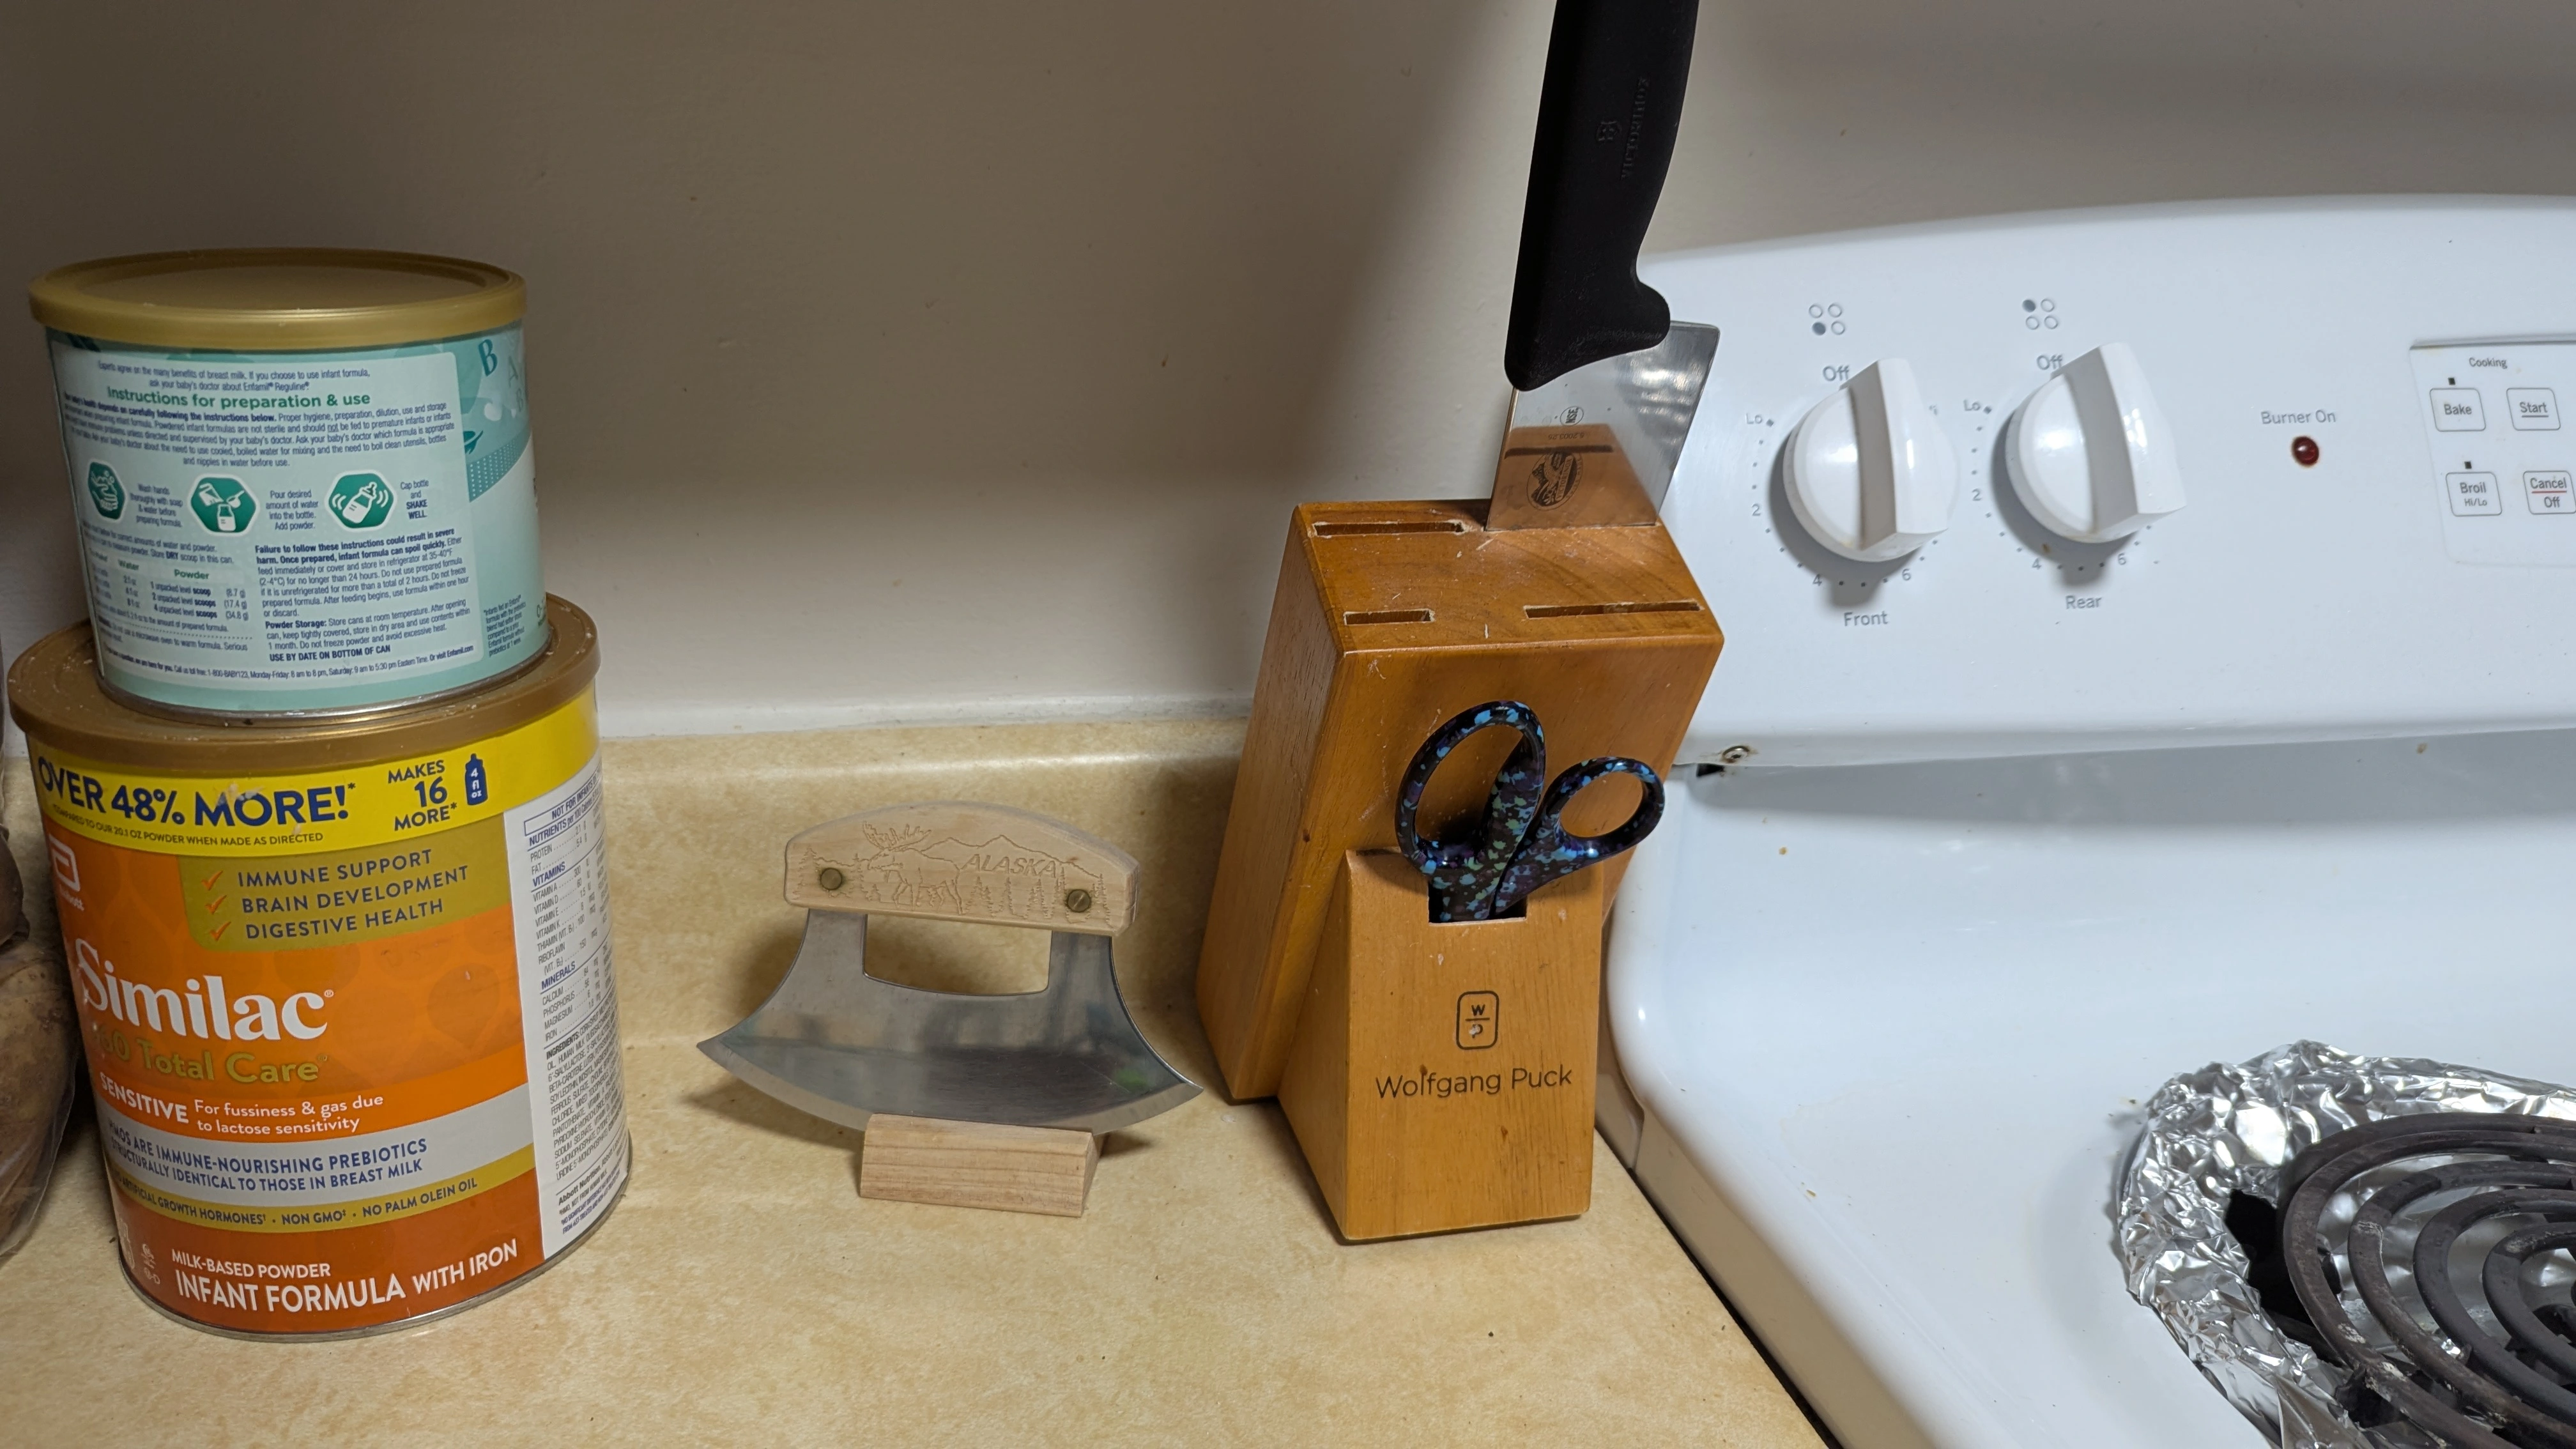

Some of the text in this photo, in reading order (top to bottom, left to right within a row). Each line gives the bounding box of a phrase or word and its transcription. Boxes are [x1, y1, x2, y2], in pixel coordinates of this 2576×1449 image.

[2036, 355, 2064, 371] Off
[2469, 357, 2508, 369] Cooking
[1823, 365, 1850, 382] Off
[107, 386, 188, 406] Instructions
[192, 394, 215, 408] for
[220, 394, 321, 410] preparation
[326, 394, 338, 407] &
[343, 394, 371, 406] use
[1963, 400, 1981, 413] Lo
[2444, 404, 2472, 415] Bake
[2520, 402, 2547, 414] Start
[1745, 413, 1763, 425] Lo
[2260, 410, 2337, 425] Burner On
[400, 480, 429, 491] Cap bottle
[2460, 482, 2487, 494] Broil
[2529, 477, 2567, 490] Cancel
[270, 489, 312, 499] Pour desired
[411, 490, 422, 499] and
[1972, 488, 1981, 502] 2
[2464, 498, 2488, 507] Hi/Lo
[2544, 496, 2560, 509] Off
[265, 500, 319, 510] amount of water
[406, 500, 427, 510] SHAKE
[1752, 503, 1761, 517] 2
[269, 512, 280, 520] into
[295, 510, 317, 519] bottle.
[408, 510, 427, 519] WELL
[274, 521, 316, 532] Add powder.
[255, 544, 281, 553] Failure
[293, 544, 316, 553] follow
[318, 542, 339, 551] these
[341, 539, 384, 549] instructions
[386, 536, 405, 546] could
[406, 532, 425, 542] result
[427, 531, 433, 539] in
[435, 528, 454, 537] severe
[256, 556, 279, 565] harm.
[280, 555, 299, 564] Once
[301, 553, 338, 565] prepared,
[339, 551, 360, 561] infant
[362, 548, 389, 559] formula
[390, 546, 403, 555] can
[405, 544, 420, 554] spoil
[422, 540, 446, 551] quickly.
[2117, 553, 2127, 566] 6
[2032, 558, 2043, 571] 4
[174, 569, 210, 580] Powder
[1812, 574, 1823, 587] 4
[1901, 569, 1912, 581] 6
[2066, 594, 2102, 611] Rear
[265, 619, 327, 629] Powder Storage:
[1843, 610, 1889, 627] Front
[269, 645, 391, 662] USE BY DATE ON BOTTOM OF CAN
[388, 760, 445, 784] MAKES
[471, 767, 479, 778] 4
[38, 756, 106, 814] OVER
[111, 785, 186, 825] 48%
[415, 776, 447, 808] 16
[471, 790, 482, 799] oz
[551, 797, 577, 820] NOT FOR
[85, 818, 96, 829] TO
[95, 822, 114, 834] OUR
[130, 830, 142, 839] OZ
[144, 832, 185, 843] POWDER
[186, 836, 217, 845] WHEN
[220, 837, 251, 846] MADE
[254, 836, 267, 846] AS
[269, 832, 323, 845] DIRECTED
[529, 818, 567, 847] NUTRIENTS
[530, 843, 553, 862] PROTEIN
[238, 848, 432, 887] IMMUNE SUPPORT
[532, 862, 542, 875] FAT
[532, 861, 566, 887] VITAMINS
[960, 853, 1059, 879] ALASKA
[241, 865, 468, 914] BRAIN DEVELOPMENT
[246, 898, 443, 939] DIGESTIVE HEALTH
[540, 960, 576, 990] MINERALS
[542, 986, 564, 1006] CALCIUM
[543, 991, 575, 1019] PHOSPHORUS
[1471, 1004, 1485, 1016] W
[544, 1004, 573, 1030] MAGNESIUM
[545, 1029, 558, 1043] IRON
[546, 1031, 580, 1060] INGREDIENTS:
[136, 1037, 215, 1080] Total
[1375, 1064, 1573, 1099] Wolfgang Puck
[100, 1071, 383, 1124] SENSITIVE For fussiness & gas due
[197, 1116, 360, 1135] to lactose sensitivity
[134, 1137, 154, 1156] ARE
[157, 1144, 323, 1175] IMMUNE-NOURISHING
[329, 1138, 427, 1170] PREBIOTICS
[172, 1167, 236, 1190] IDENTICAL
[238, 1177, 256, 1191] TO
[261, 1177, 308, 1192] THOSE
[310, 1176, 326, 1190] IN
[330, 1168, 383, 1188] BREAST
[387, 1158, 423, 1179] MILK
[158, 1196, 197, 1218] GROWTH
[282, 1213, 310, 1225] NON
[362, 1204, 382, 1218] NO
[385, 1197, 418, 1214] PALM
[420, 1188, 456, 1206] OLEIN
[458, 1182, 478, 1198] OIL
[558, 1186, 579, 1206] Abbott
[172, 1248, 254, 1277] MILK-BASED
[257, 1263, 331, 1279] POWDER
[175, 1238, 518, 1313] INFANT FORMULA WITH IRON
